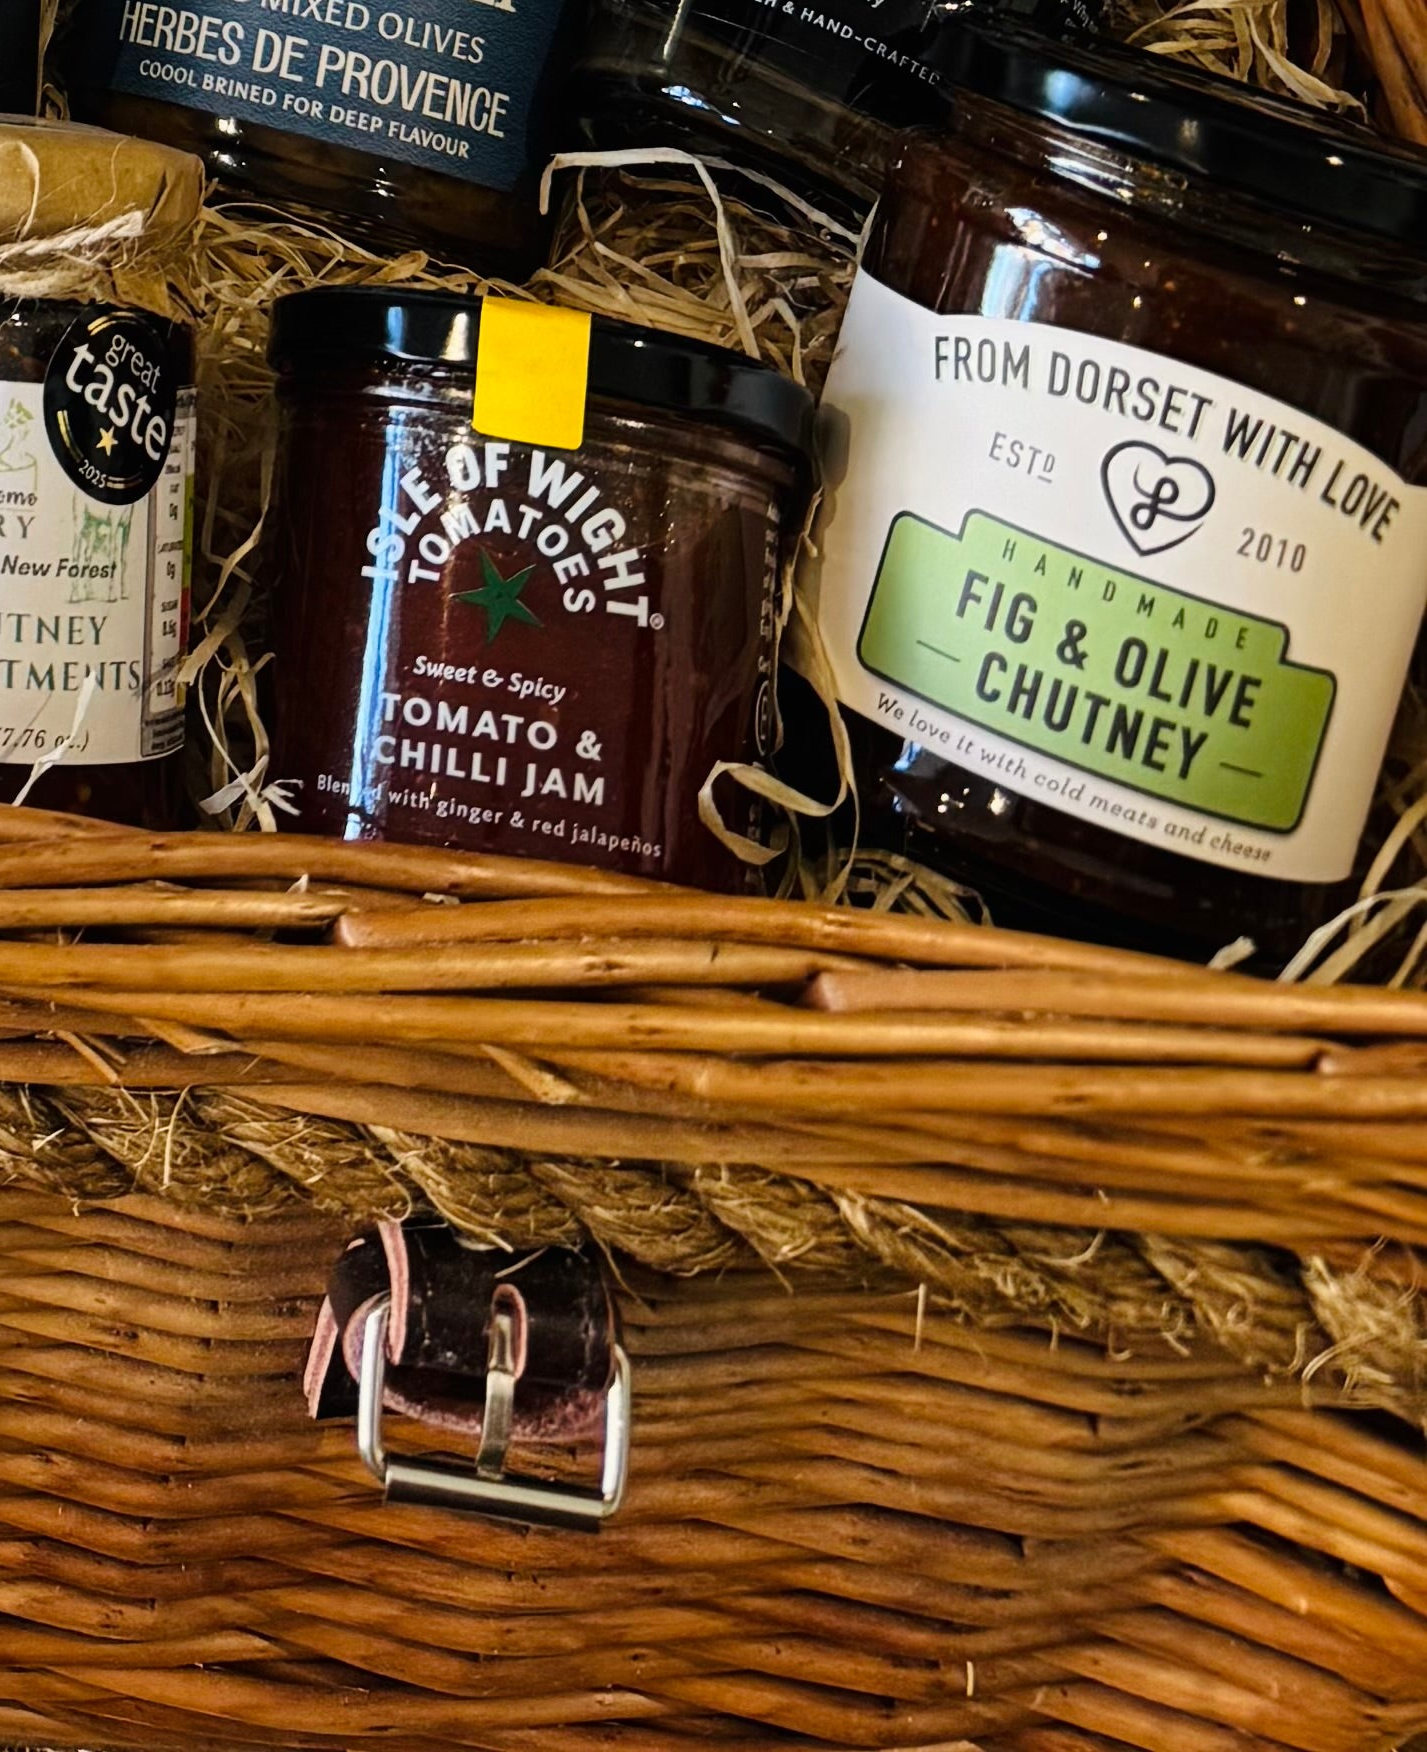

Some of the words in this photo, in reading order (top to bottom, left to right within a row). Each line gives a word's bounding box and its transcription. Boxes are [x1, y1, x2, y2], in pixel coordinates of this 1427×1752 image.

[119, 0, 245, 66] HERBES
[252, 29, 309, 81] DE
[315, 44, 511, 138] PROVENCE
[933, 335, 1033, 389] FROM
[1047, 350, 1215, 439] DORSET
[1222, 406, 1326, 490] WITH
[1320, 457, 1401, 545] LOVE
[954, 568, 1038, 646] FIG
[1055, 619, 1088, 671] &
[1113, 636, 1263, 730] OLIVE
[1001, 538, 1251, 651] HANDMADE
[378, 692, 558, 751] TOMATO
[413, 655, 477, 686] Sweet
[482, 667, 504, 688] &
[508, 672, 567, 706] Spicy
[974, 652, 1211, 782] CHUTNEY
[372, 735, 508, 787] CHILLI
[521, 762, 605, 807] JAM
[570, 822, 662, 859] jalapeños
